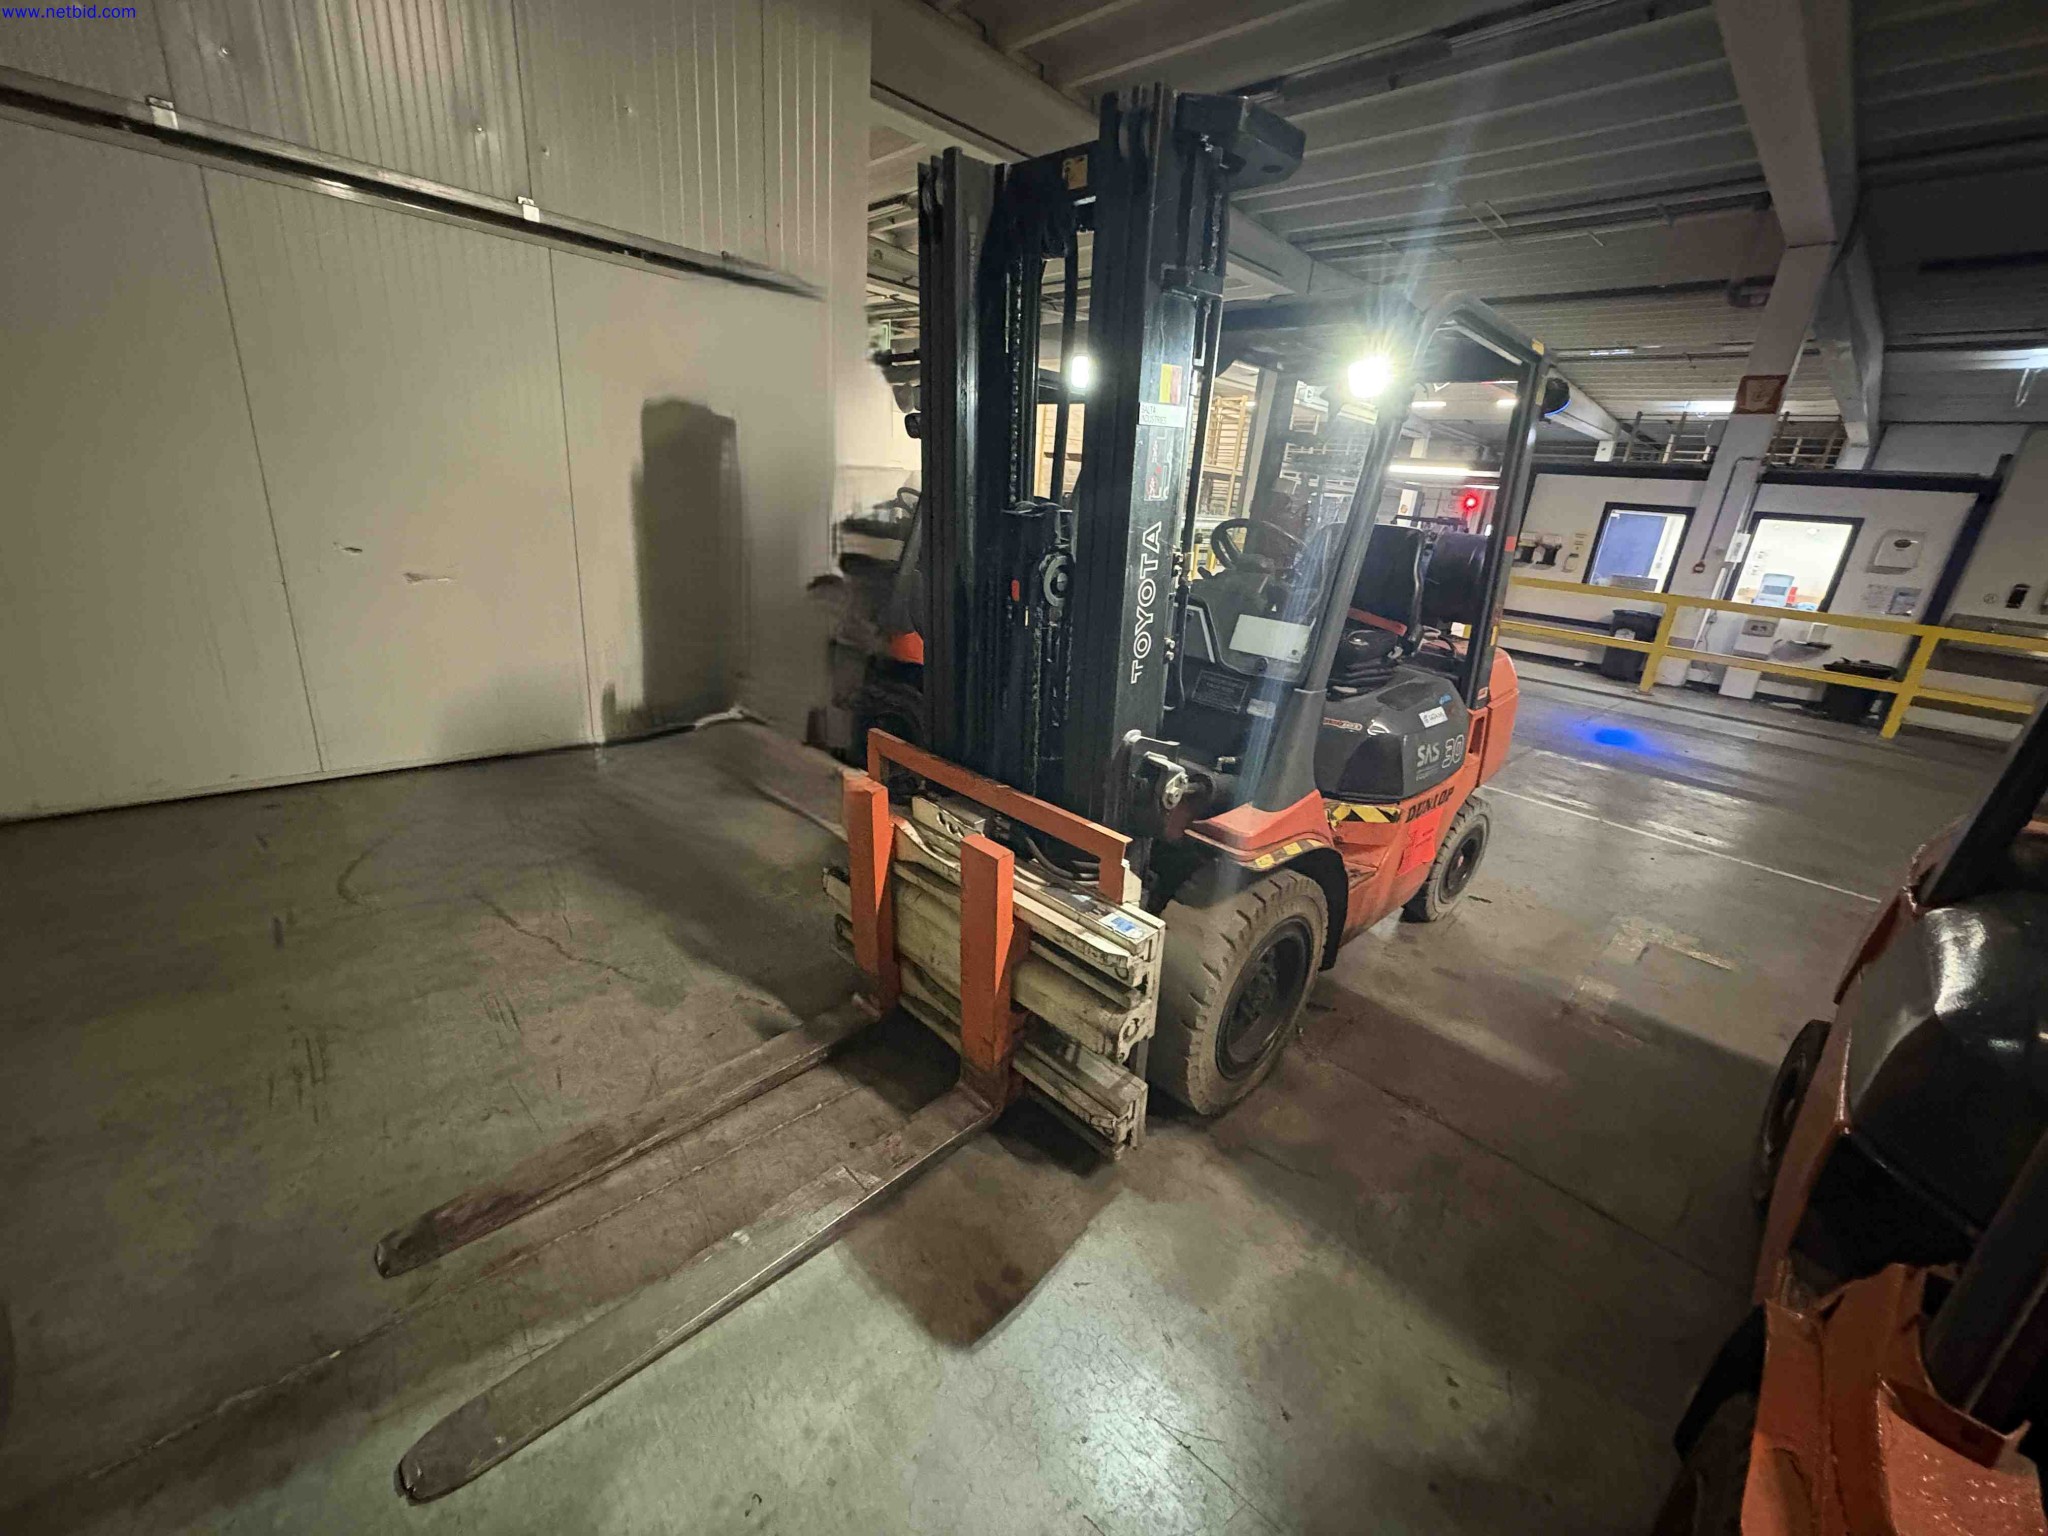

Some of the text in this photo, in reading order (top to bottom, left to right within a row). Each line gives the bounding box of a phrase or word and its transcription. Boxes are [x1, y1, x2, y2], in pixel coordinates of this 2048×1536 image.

[1131, 521, 1162, 684] TOYOTA
[1417, 734, 1465, 769] SAS 30
[1405, 786, 1455, 823] DUNLOP
